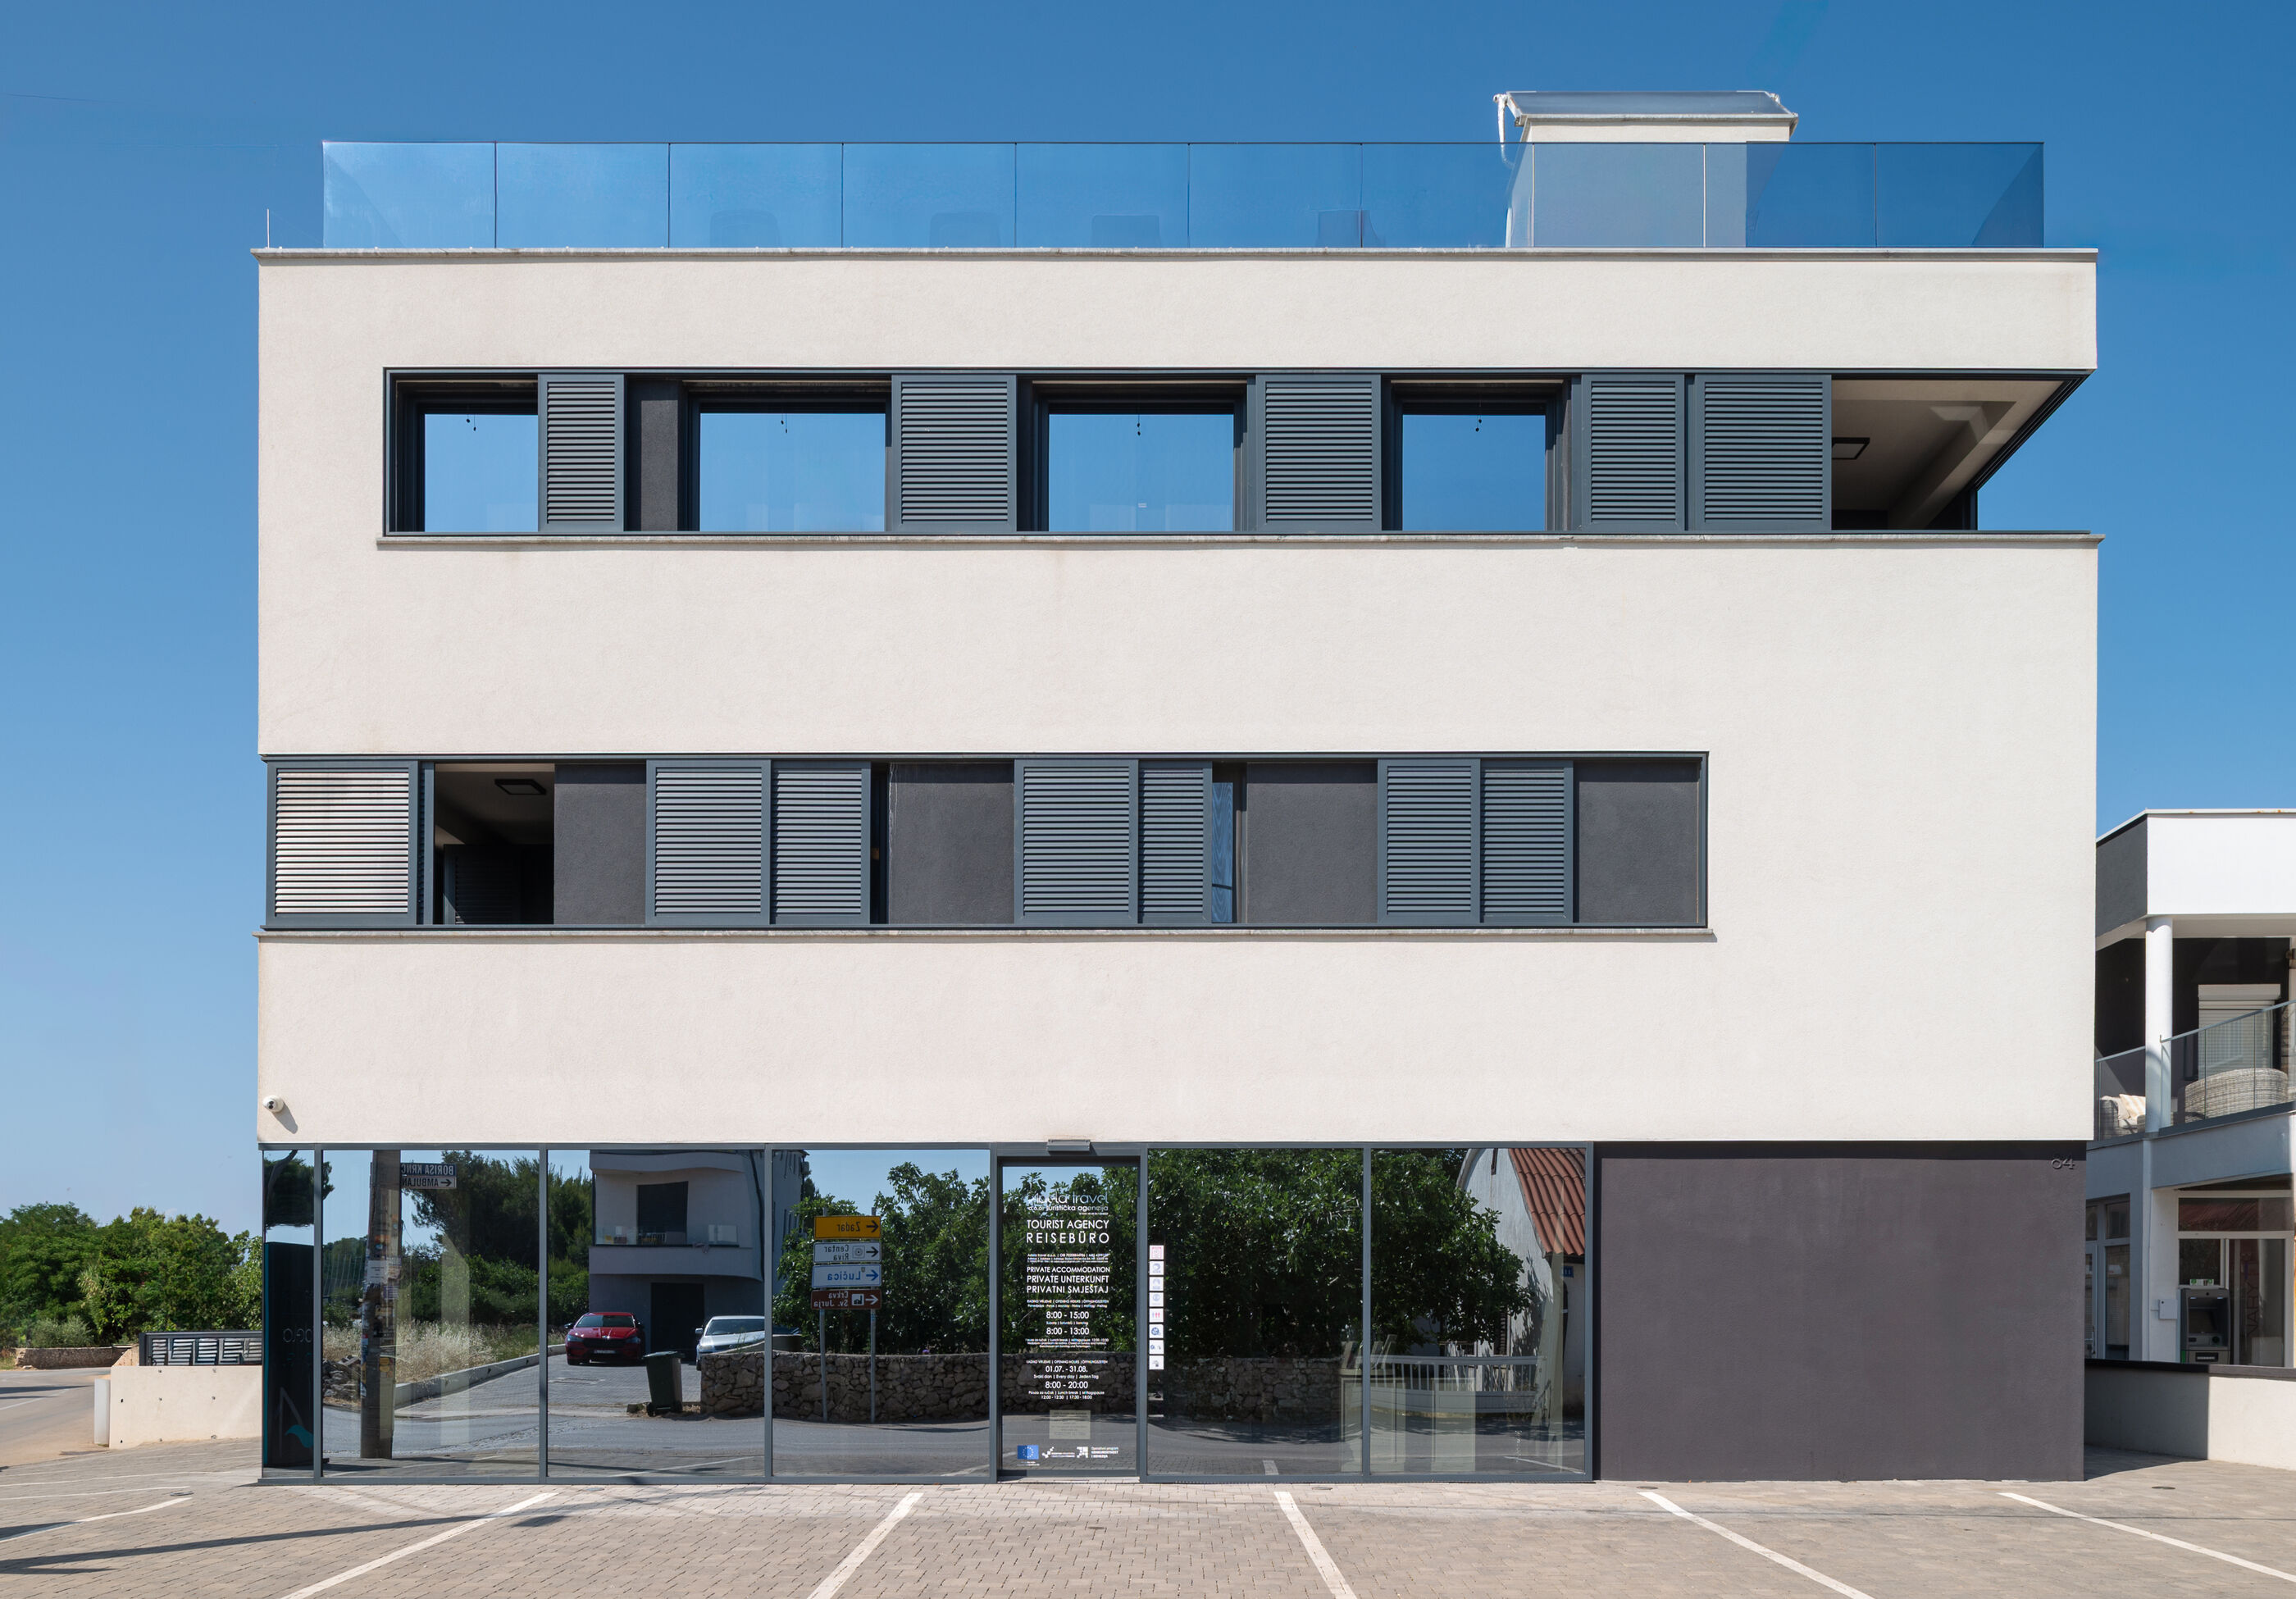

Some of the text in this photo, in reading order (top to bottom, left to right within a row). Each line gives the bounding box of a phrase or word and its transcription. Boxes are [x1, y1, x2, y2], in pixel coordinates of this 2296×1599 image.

[1073, 1191, 1109, 1204] travel
[1027, 1220, 1109, 1229] TOURIST AGENCY
[1027, 1231, 1109, 1244] REISEBÜRO
[1027, 1275, 1109, 1283] PRIVATE UNTERKUNFT
[1027, 1285, 1109, 1293] PRIVATNI SMJEŠTAJ
[1046, 1311, 1062, 1319] 8:00
[1069, 1311, 1089, 1319] 15:00
